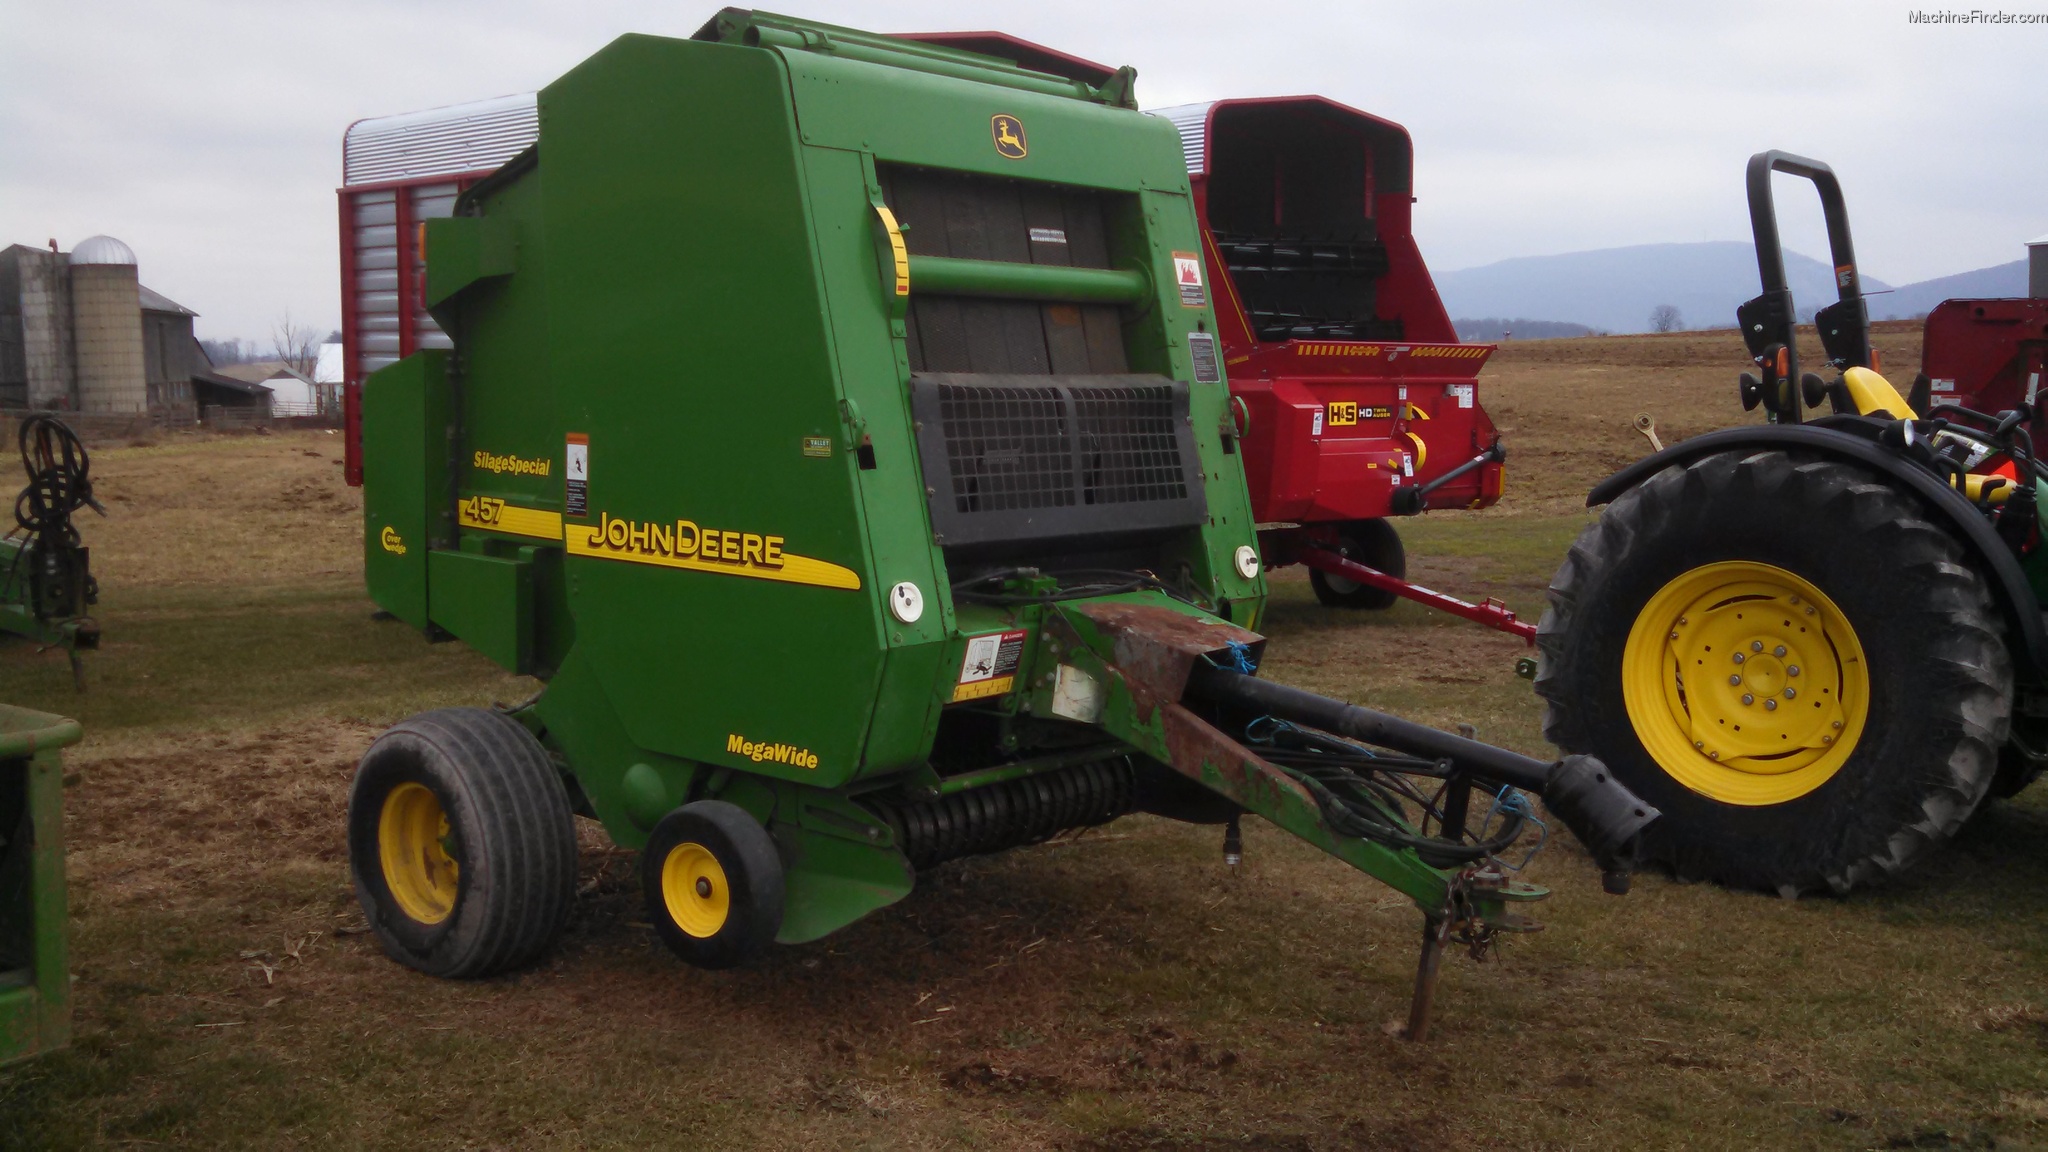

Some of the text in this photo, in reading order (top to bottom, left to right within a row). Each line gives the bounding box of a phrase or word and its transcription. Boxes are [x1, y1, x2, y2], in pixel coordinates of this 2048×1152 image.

[1358, 408, 1373, 418] HD
[474, 450, 551, 476] SilageSpecial
[465, 495, 505, 525] 457
[727, 733, 819, 769] MegaWide
